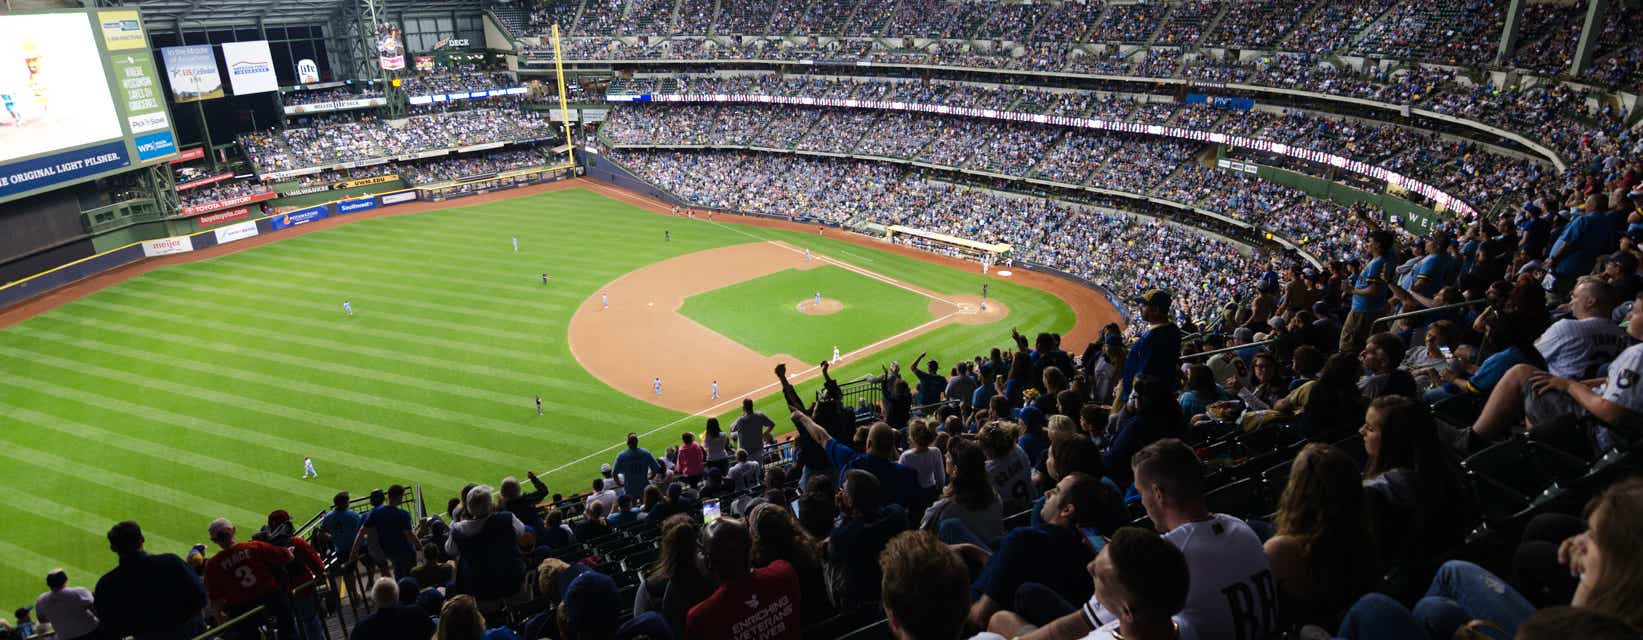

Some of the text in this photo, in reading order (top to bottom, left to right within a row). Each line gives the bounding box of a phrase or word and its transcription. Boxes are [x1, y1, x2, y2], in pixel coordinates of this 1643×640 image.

[301, 63, 315, 75] Lite
[10, 167, 56, 184] ORIGINAL
[56, 160, 84, 174] LIGHT
[84, 152, 121, 168] PILSNER.
[195, 196, 252, 212] TOYOTA TERRITORY
[341, 202, 371, 211] Southwest
[152, 240, 181, 249] meijer
[235, 565, 257, 587] 3
[731, 594, 790, 634] ENRICHING
